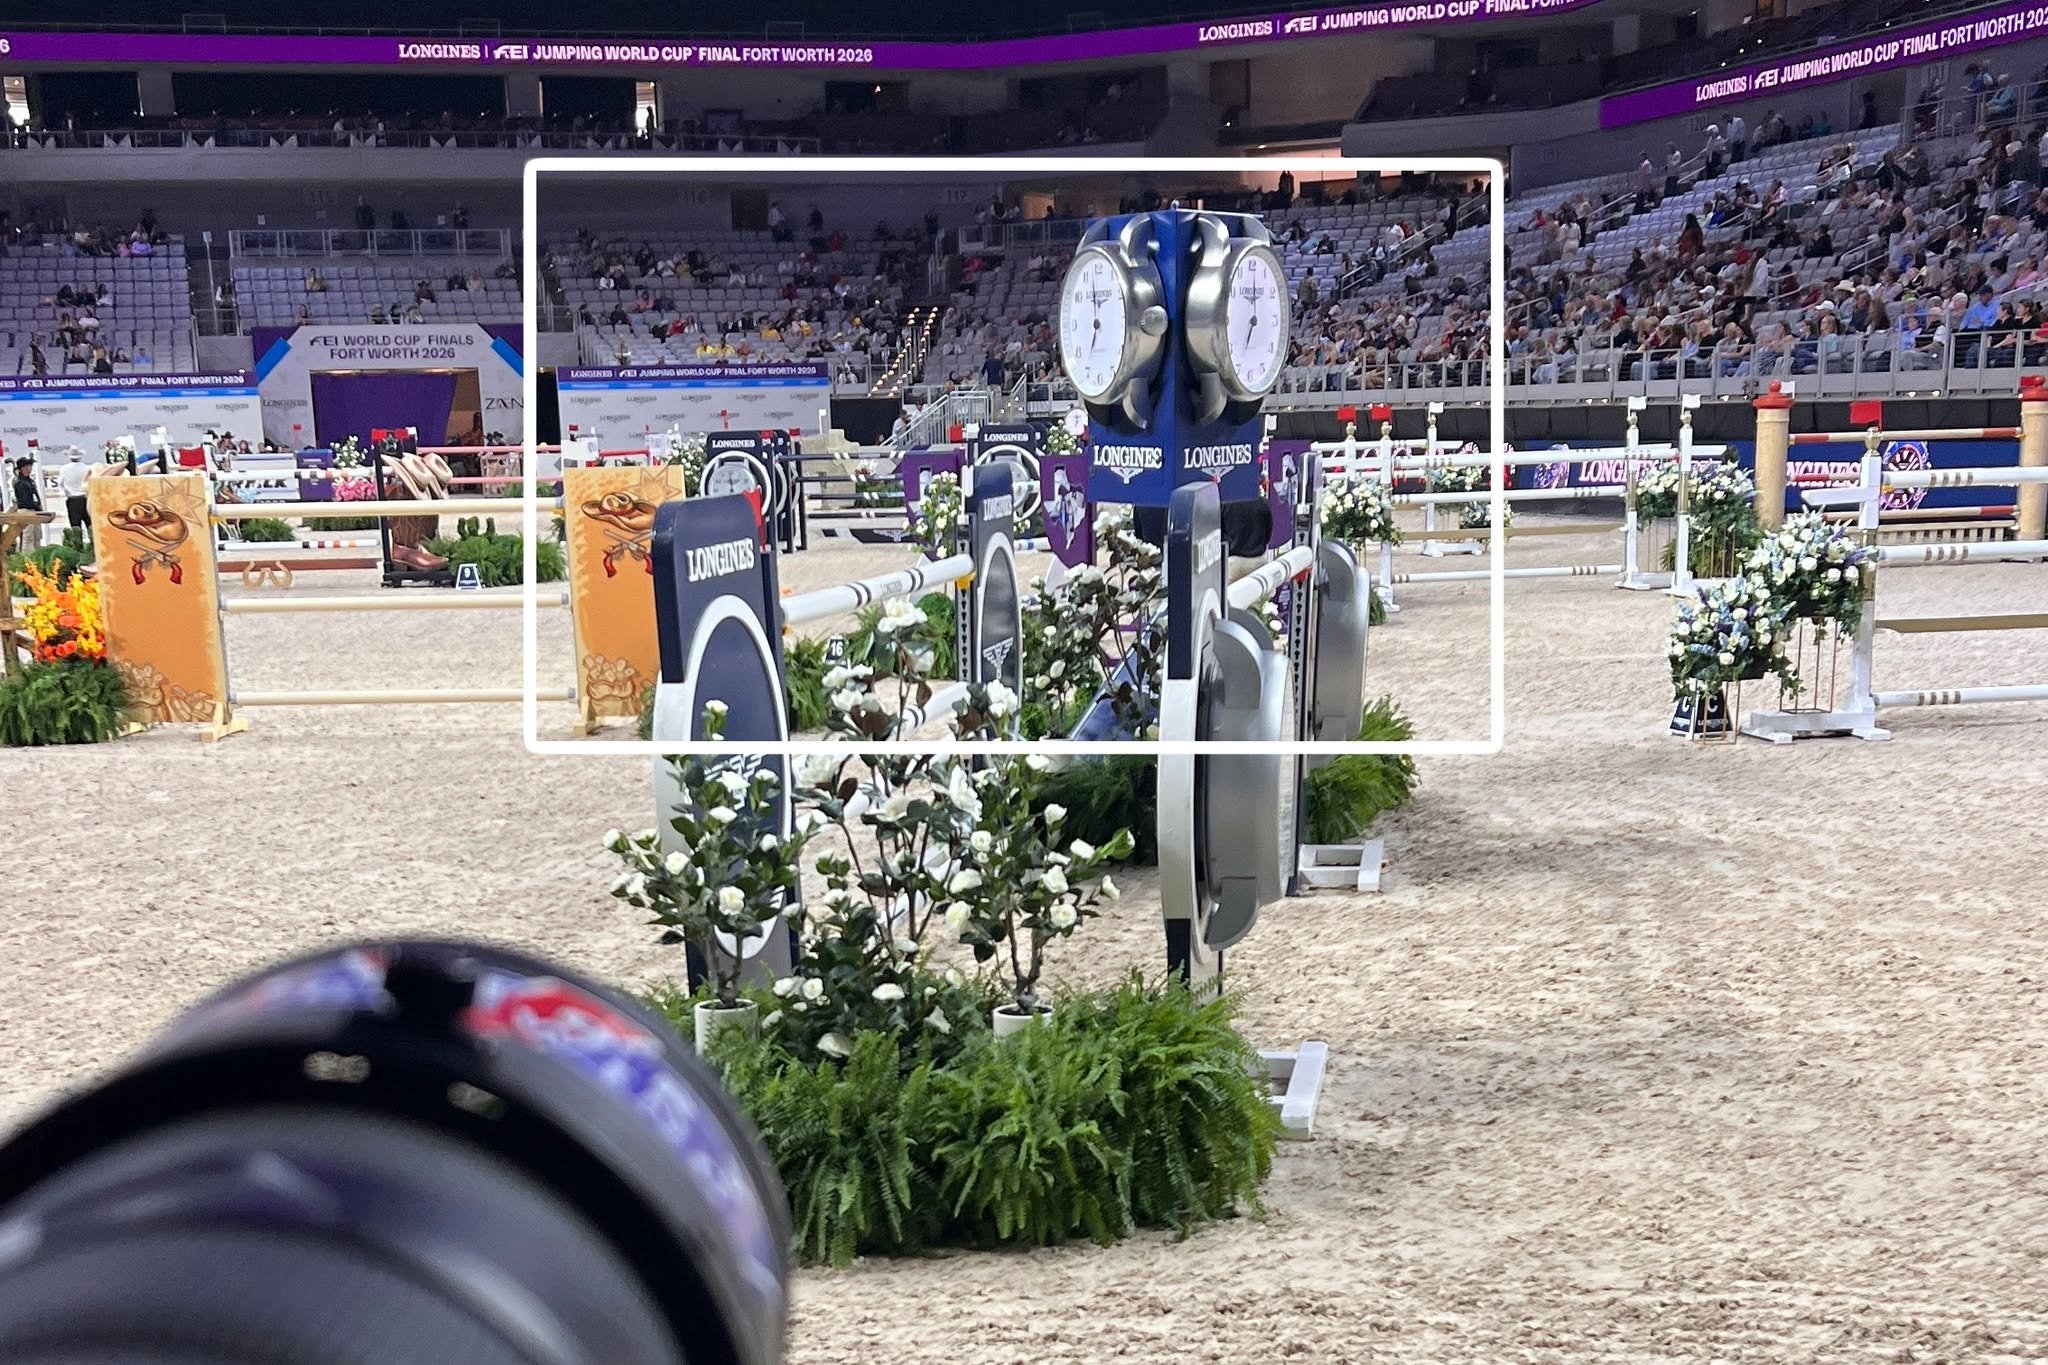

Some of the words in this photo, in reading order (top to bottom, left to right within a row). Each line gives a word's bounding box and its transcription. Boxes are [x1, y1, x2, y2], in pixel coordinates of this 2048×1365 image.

[1199, 21, 1273, 41] LONGINES
[1321, 10, 1389, 30] JUMPING
[1391, 4, 1446, 22] WORLD
[399, 44, 481, 59] LONGINES
[532, 45, 603, 60] JUMPING
[604, 46, 660, 61] WORLD
[699, 47, 741, 62] FINAL
[742, 47, 781, 62] FORT
[781, 48, 835, 63] WORTH
[837, 48, 873, 63] 2026
[1695, 76, 1747, 102] LONGINES
[1780, 57, 1830, 84] JUMPING
[1831, 47, 1873, 72] WORLD
[1903, 33, 1939, 57] FINAL
[1940, 24, 1974, 49] FORT
[1975, 13, 2024, 41] WORTH
[1248, 260, 1256, 271] 12
[343, 335, 391, 346] WORLD
[427, 335, 474, 346] FINALS
[330, 348, 365, 359] FORT
[367, 348, 420, 359] WORTH
[422, 347, 456, 359] 2026
[638, 369, 675, 378] JUMPING
[676, 368, 704, 377] WORLD
[724, 367, 748, 376] FINAL
[747, 367, 767, 375] FORT
[767, 366, 797, 375] WORTH
[45, 378, 86, 387] JUMPING
[86, 377, 119, 387] WORLD
[141, 377, 166, 385] FINAL
[166, 376, 190, 385] FORT
[189, 376, 221, 384] WORTH
[222, 375, 245, 384] 2026
[711, 440, 755, 448] LONGINES
[984, 433, 1029, 442] LONGINES
[1093, 444, 1163, 469] LONGINES
[1183, 443, 1252, 469] LONGINES
[685, 537, 755, 582] LONGINES
[830, 640, 844, 657] 16
[1707, 694, 1718, 712] C
